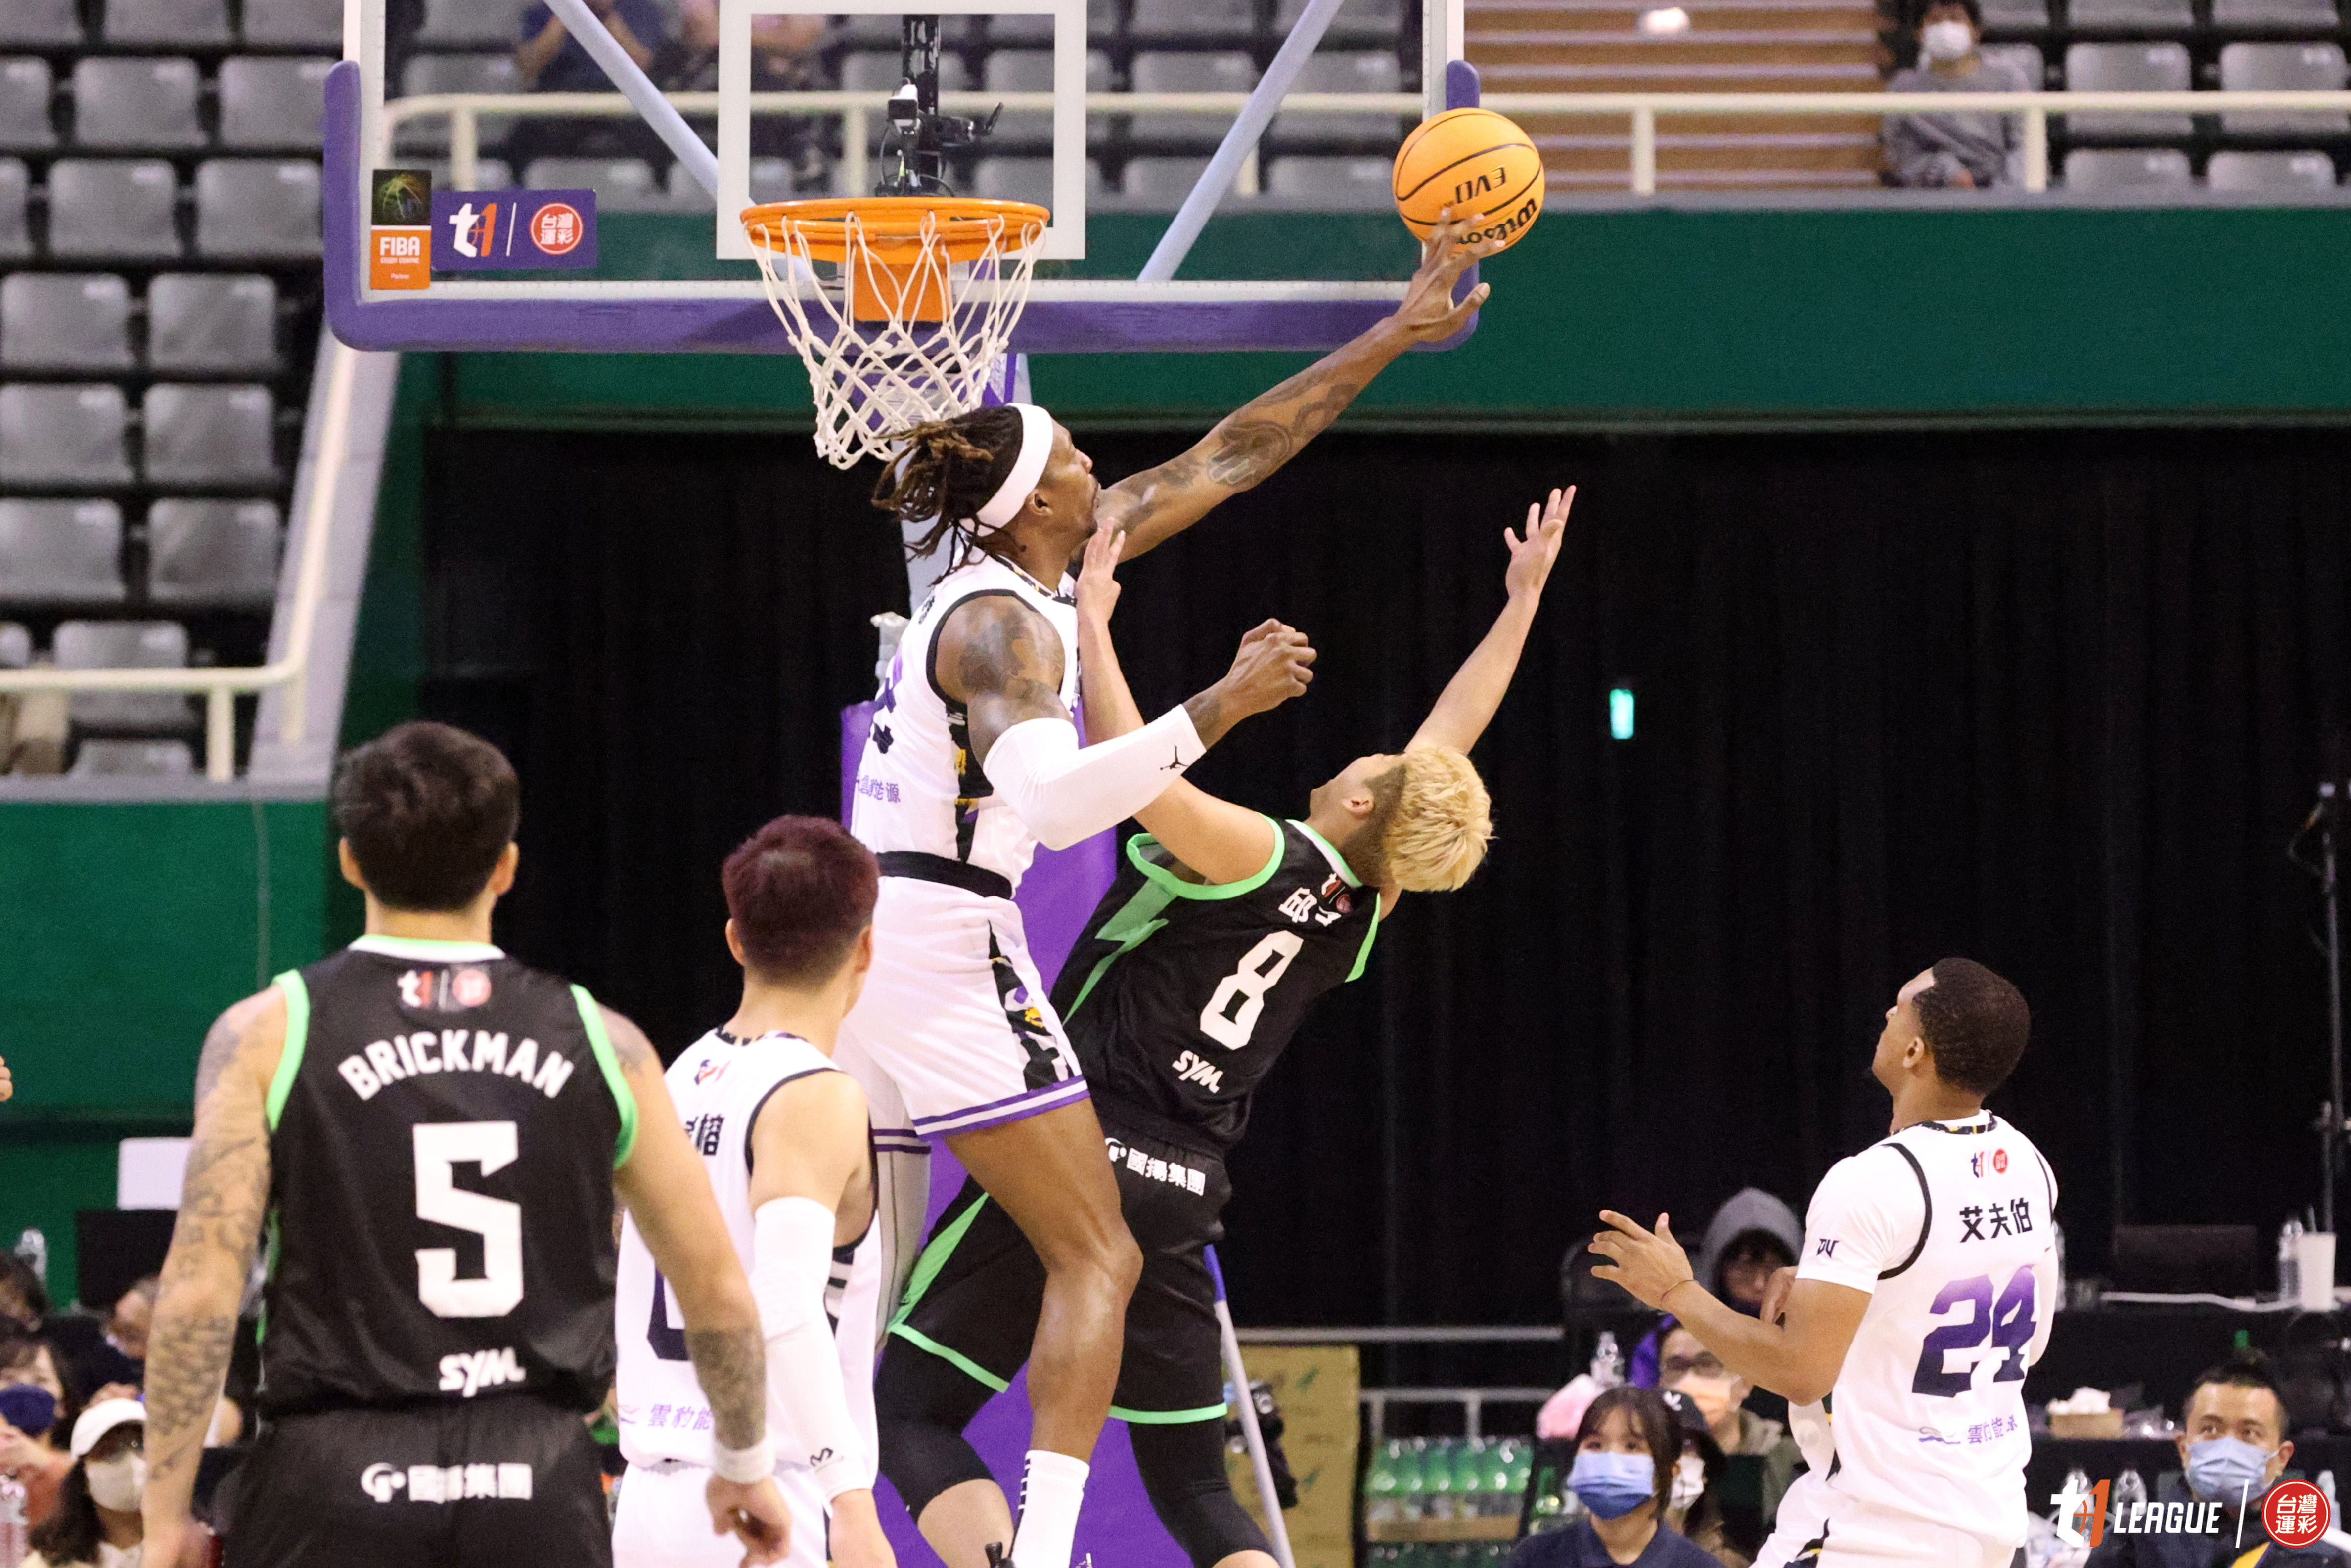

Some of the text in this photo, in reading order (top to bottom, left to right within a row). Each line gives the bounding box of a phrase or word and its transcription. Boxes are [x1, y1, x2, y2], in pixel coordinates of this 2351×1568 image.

[1454, 167, 1506, 204] EVO
[379, 236, 420, 256] FIBA
[1200, 930, 1304, 1050] 8
[338, 1029, 575, 1101] BRICKMAN
[1172, 1050, 1224, 1093] SYM
[412, 1121, 524, 1317] 5
[1959, 1197, 2033, 1243] 艾夫伯
[1912, 1264, 2037, 1398] 24
[439, 1346, 526, 1398] SYM
